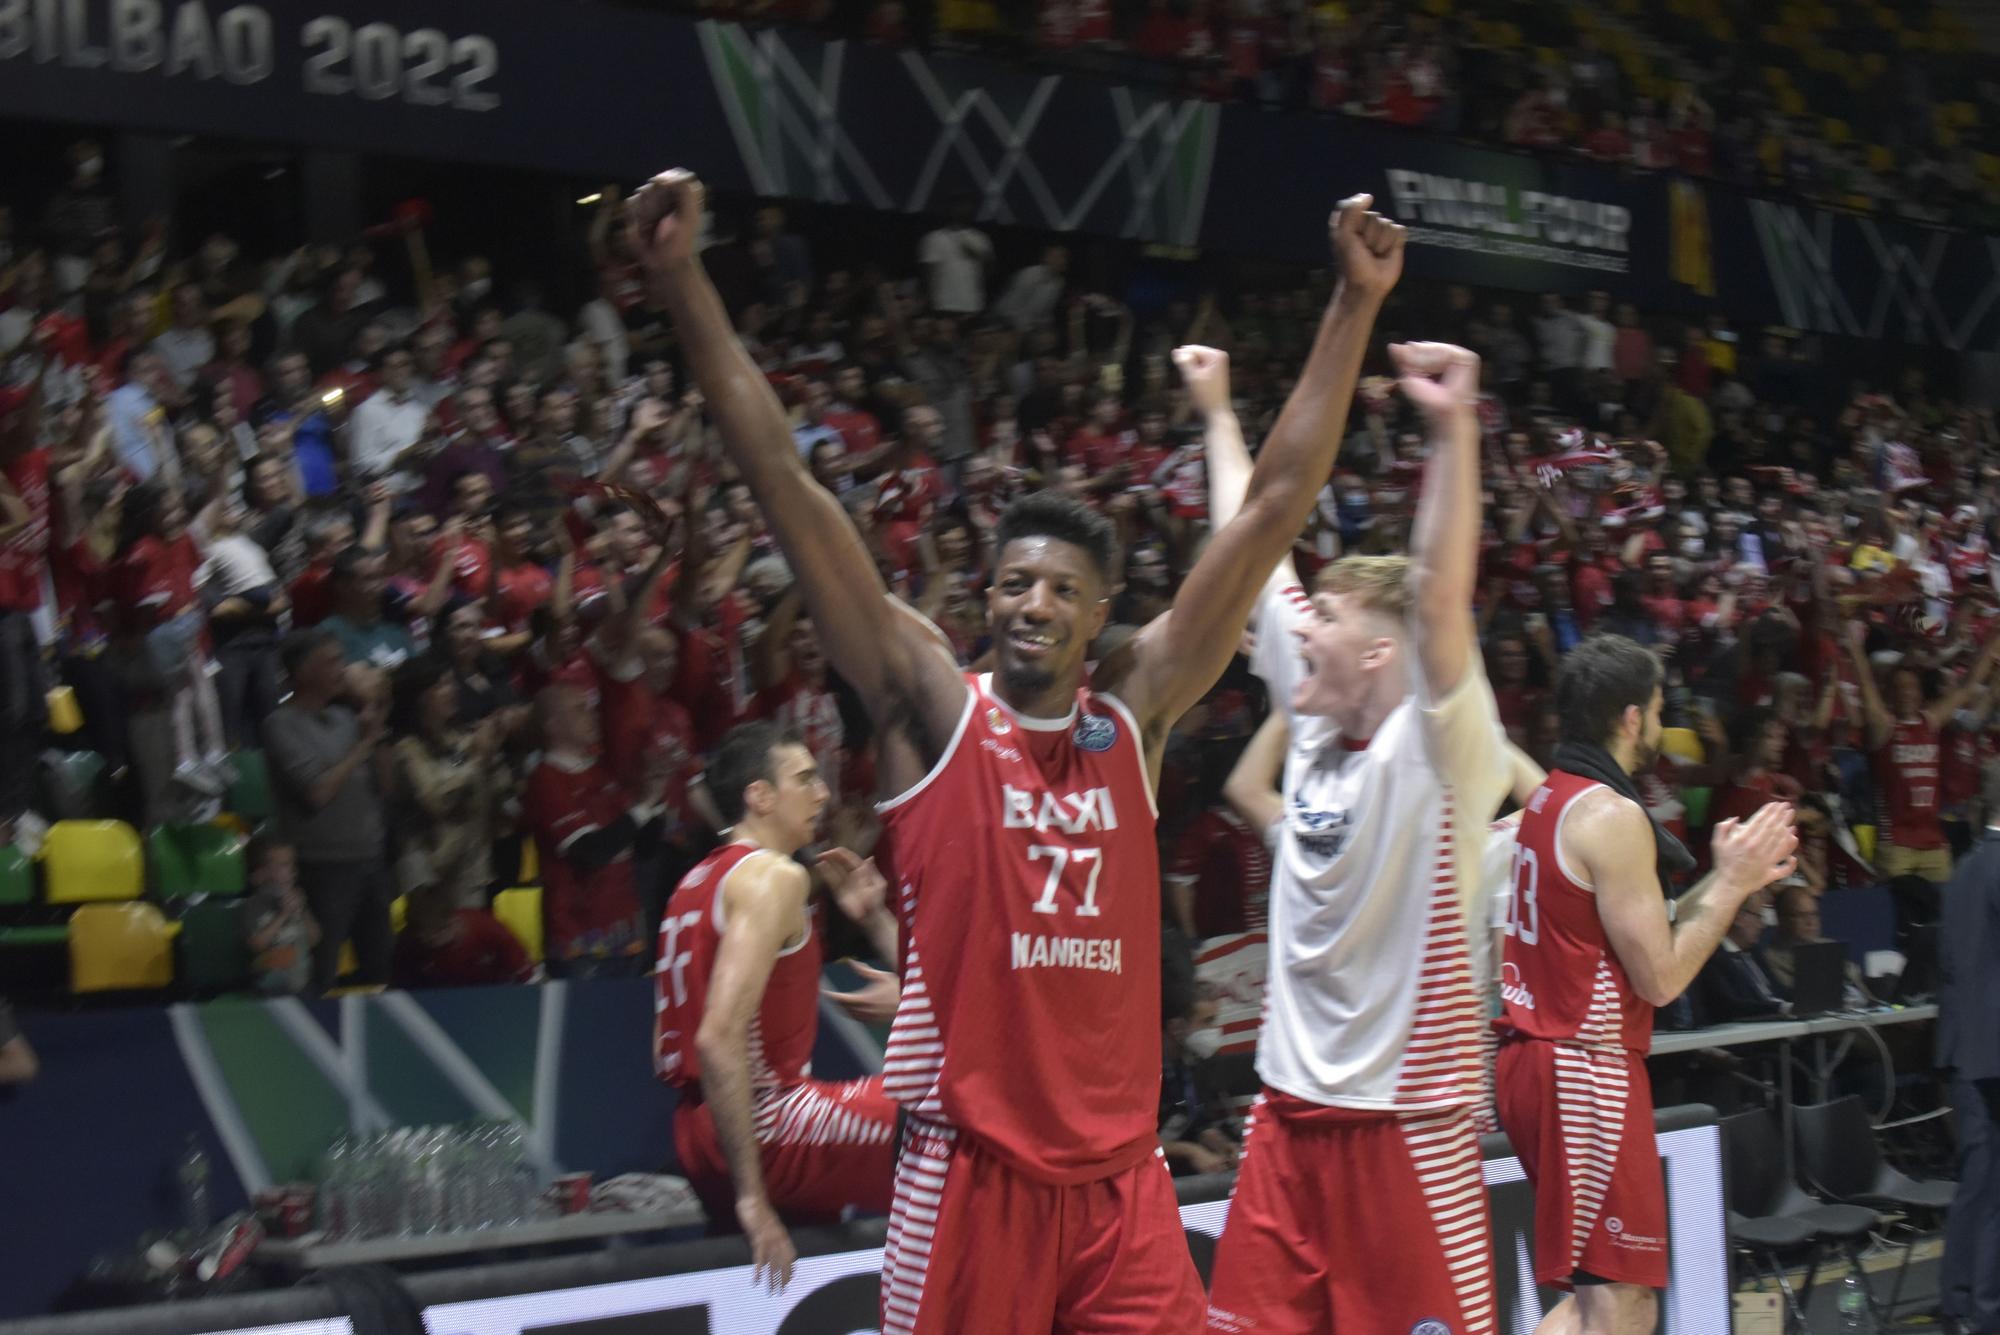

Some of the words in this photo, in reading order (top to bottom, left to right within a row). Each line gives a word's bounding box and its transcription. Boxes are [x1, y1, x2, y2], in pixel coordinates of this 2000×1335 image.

[302, 15, 501, 112] 2022
[1002, 783, 1119, 834] BAXI
[1027, 844, 1103, 917] 77
[1011, 931, 1122, 976] MANRESA
